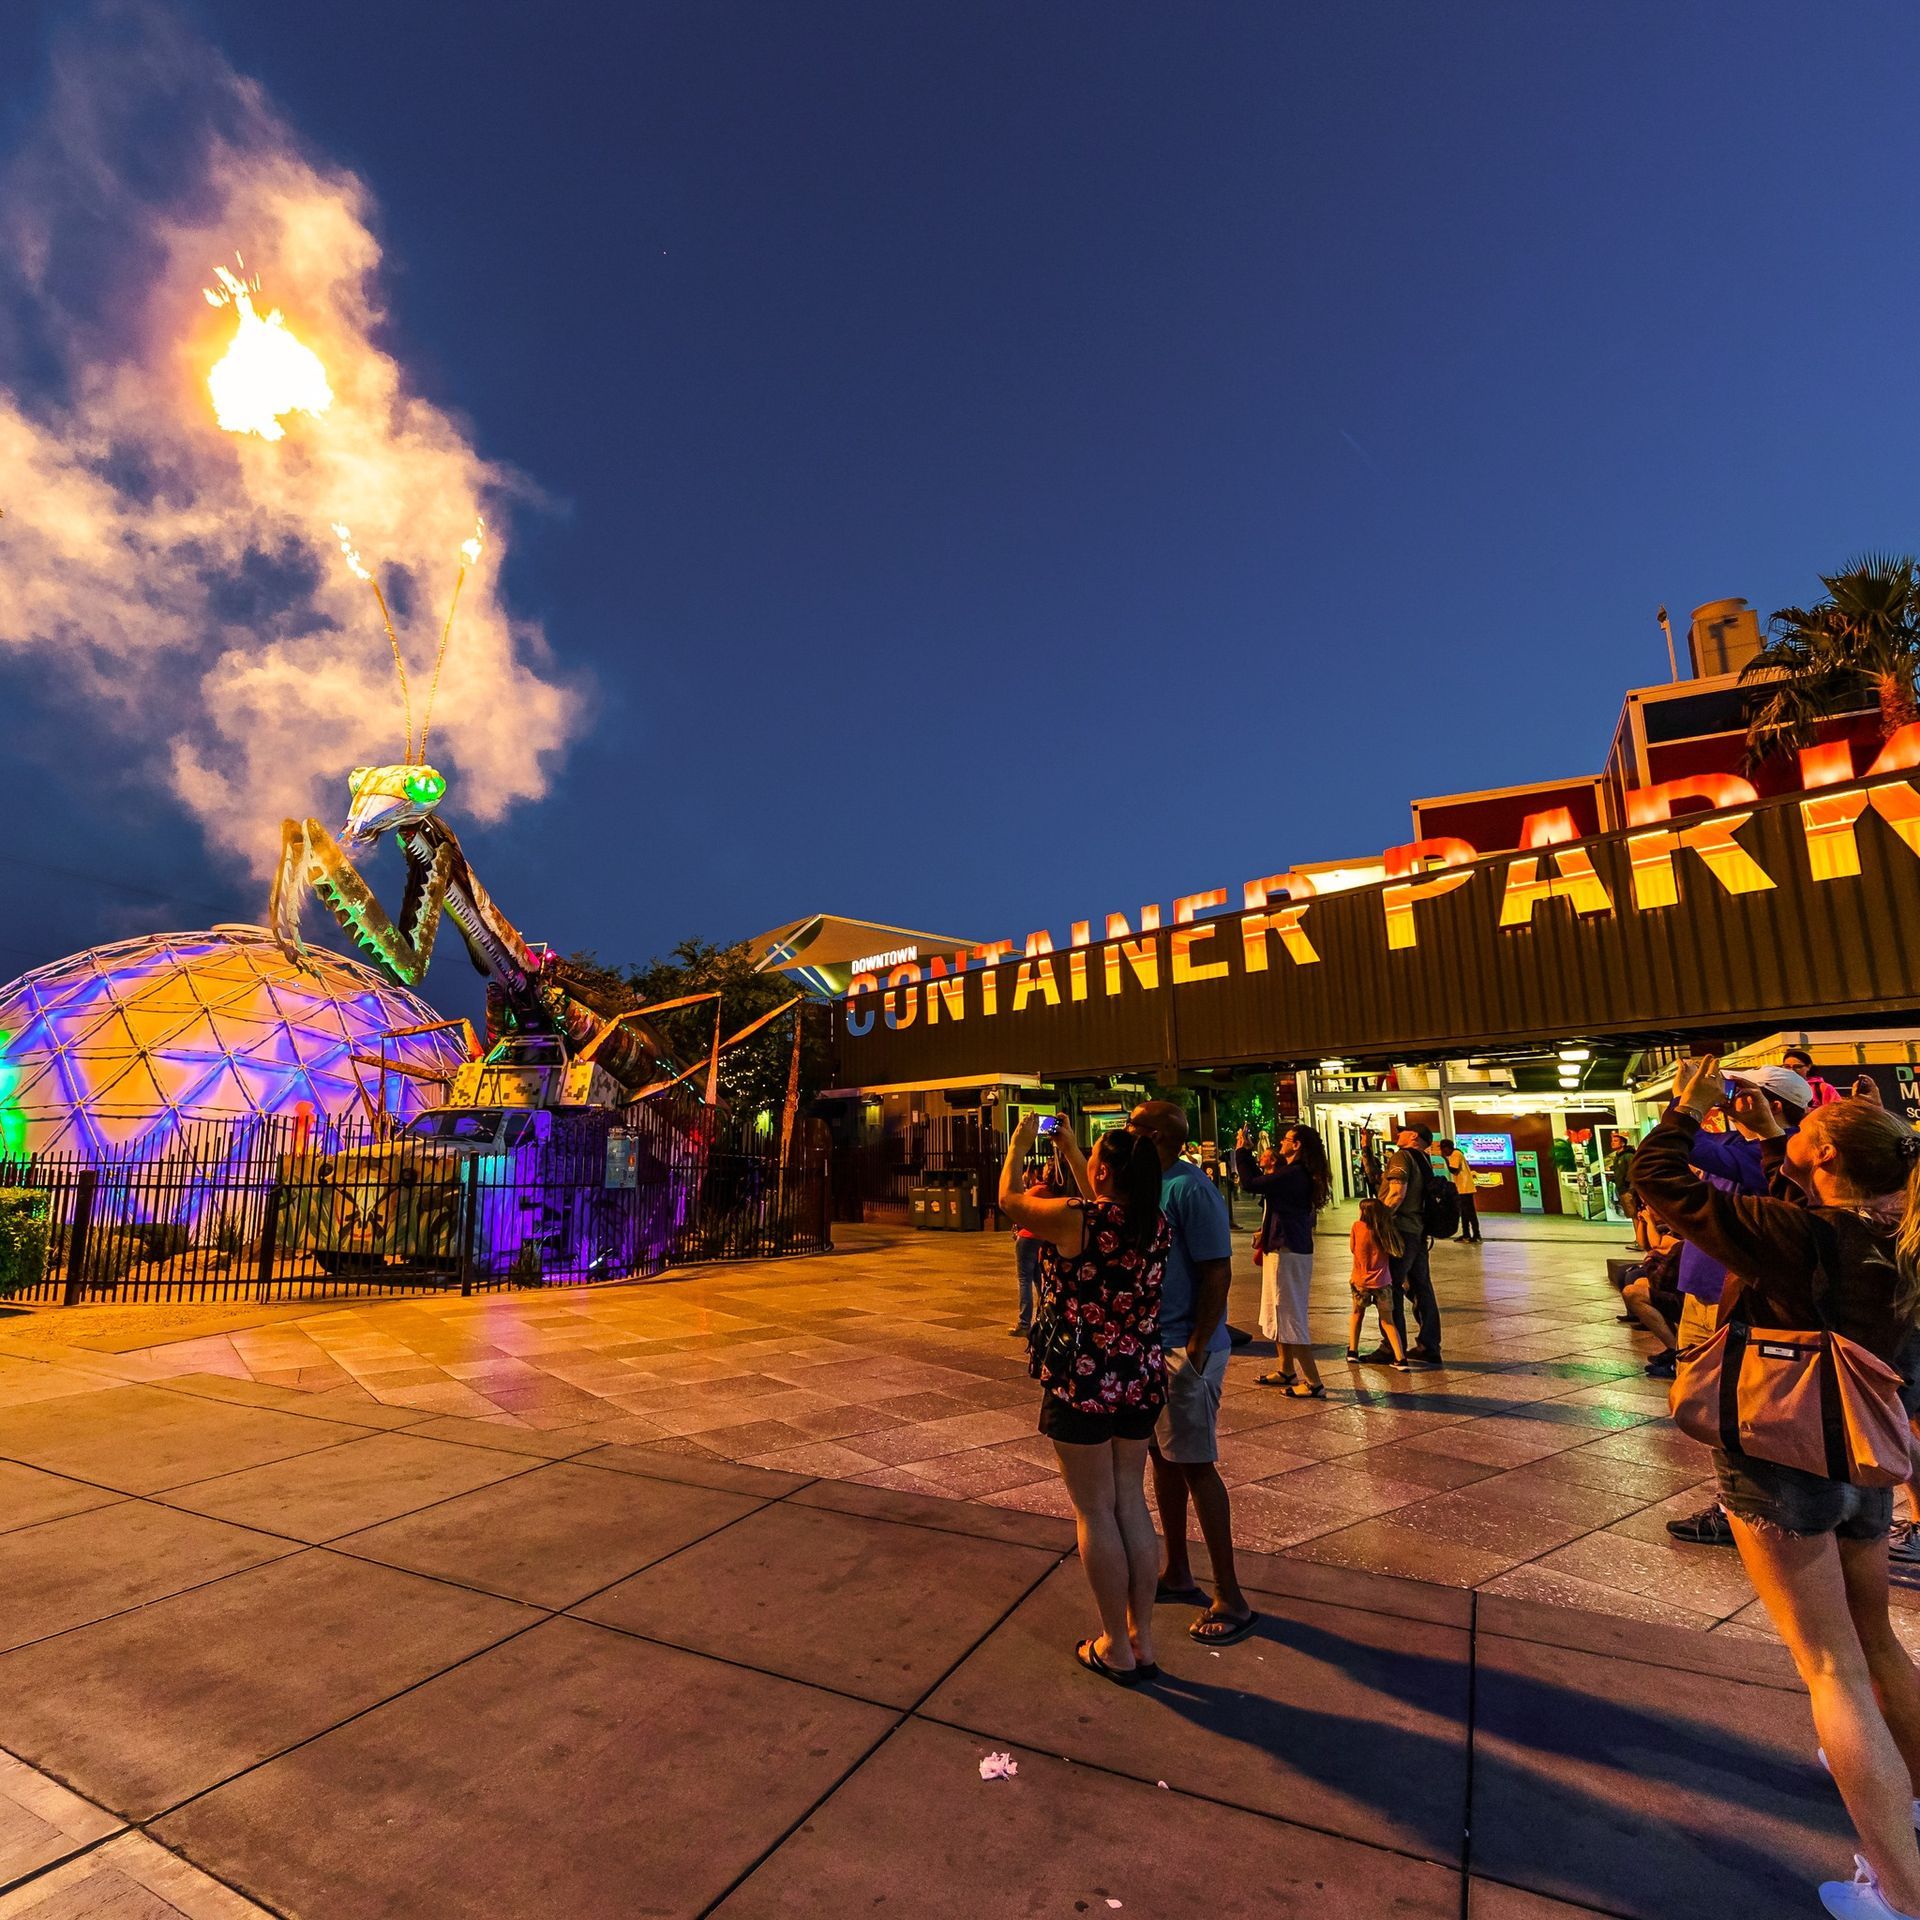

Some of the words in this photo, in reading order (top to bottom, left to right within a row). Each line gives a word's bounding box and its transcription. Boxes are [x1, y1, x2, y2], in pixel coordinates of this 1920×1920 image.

[846, 872, 1321, 1037] CONTAINER
[1383, 722, 1920, 950] PARK
[851, 945, 918, 975] DOWNTOWN
